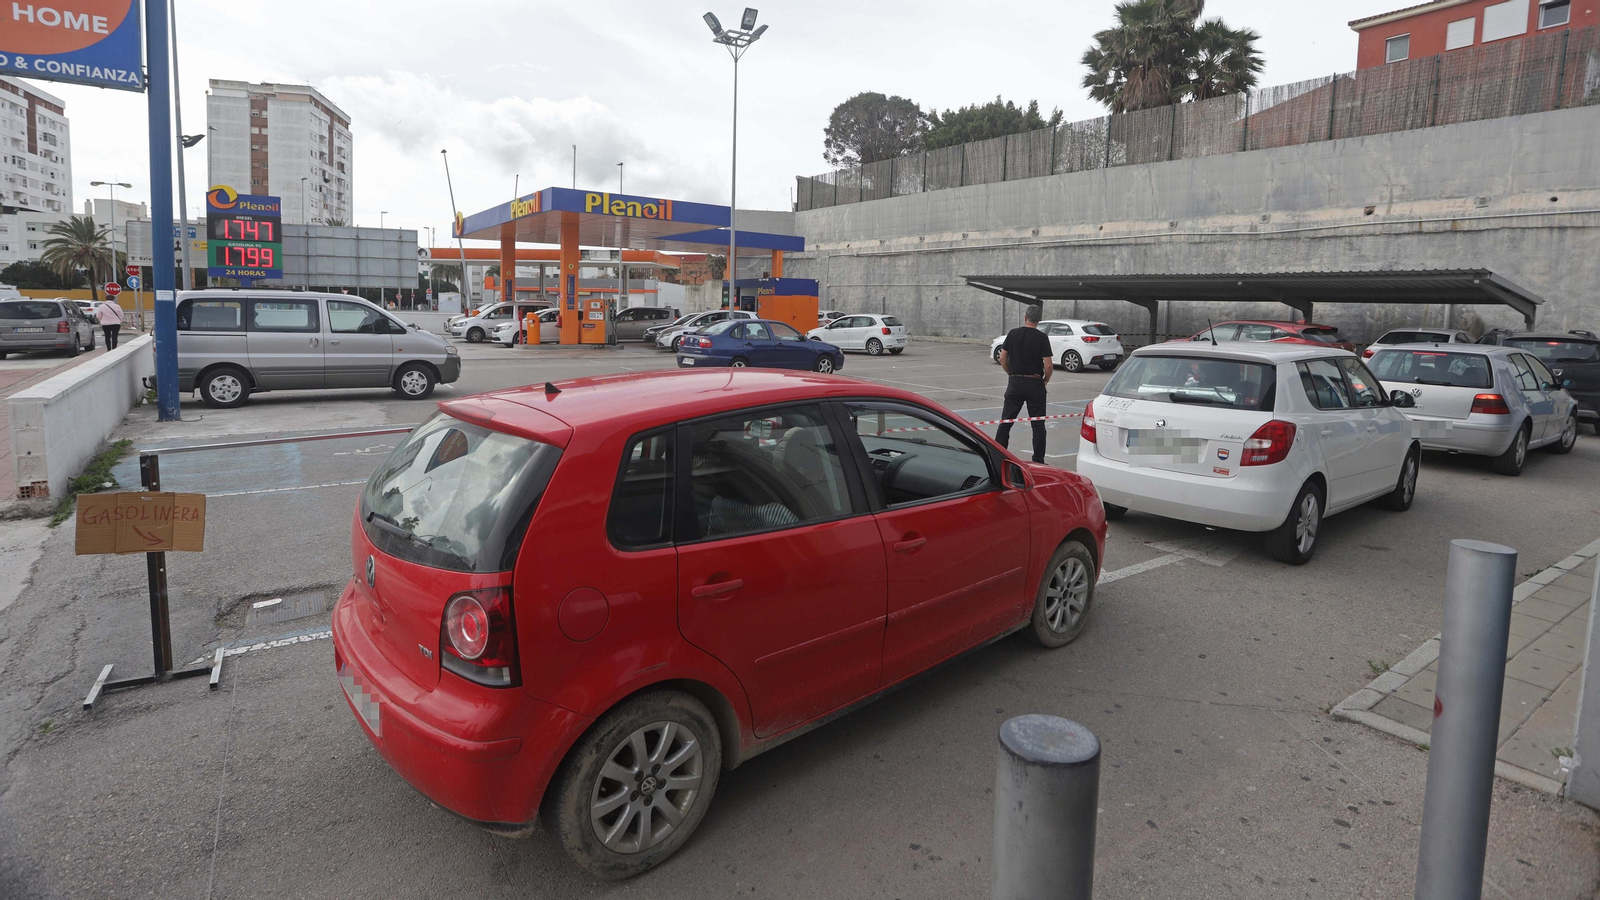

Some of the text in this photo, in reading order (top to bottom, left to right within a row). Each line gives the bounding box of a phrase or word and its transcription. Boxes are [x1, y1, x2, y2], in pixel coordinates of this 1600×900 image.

[12, 2, 109, 34] HOME
[15, 56, 28, 69] &
[34, 59, 140, 83] CONFIANZA
[240, 201, 279, 212] Plenoil
[511, 191, 541, 220] Plenoil
[585, 193, 673, 220] Plenoil
[224, 219, 273, 241] 1.747
[225, 246, 273, 268] 1.799
[82, 504, 200, 526] GASOLINERA
